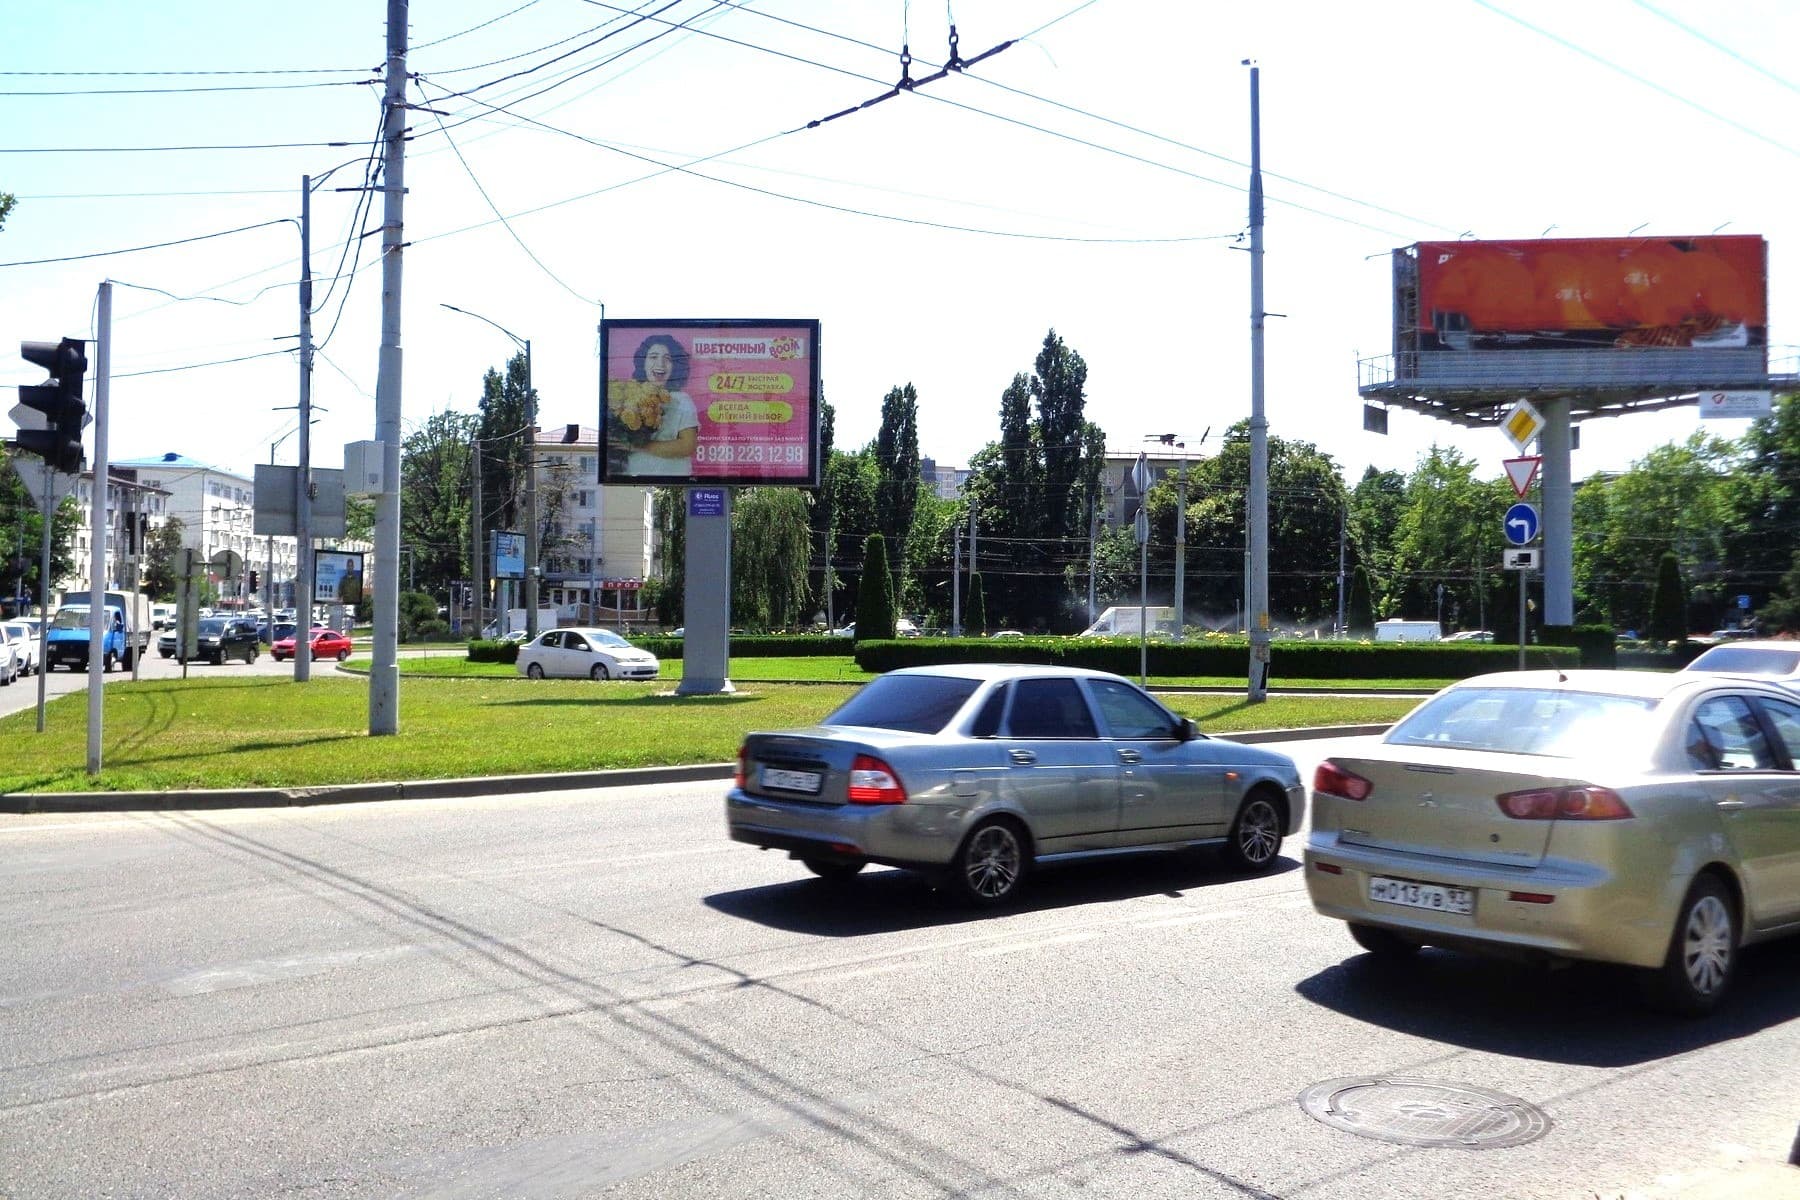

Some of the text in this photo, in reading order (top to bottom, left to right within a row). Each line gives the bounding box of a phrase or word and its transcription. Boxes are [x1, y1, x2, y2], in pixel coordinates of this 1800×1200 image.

[695, 342, 766, 355] ЦВЕТОЧНЫЙ
[716, 375, 745, 391] 24/7
[753, 413, 783, 421] ВЫБОР
[696, 445, 804, 462] 8 928 223 12 98
